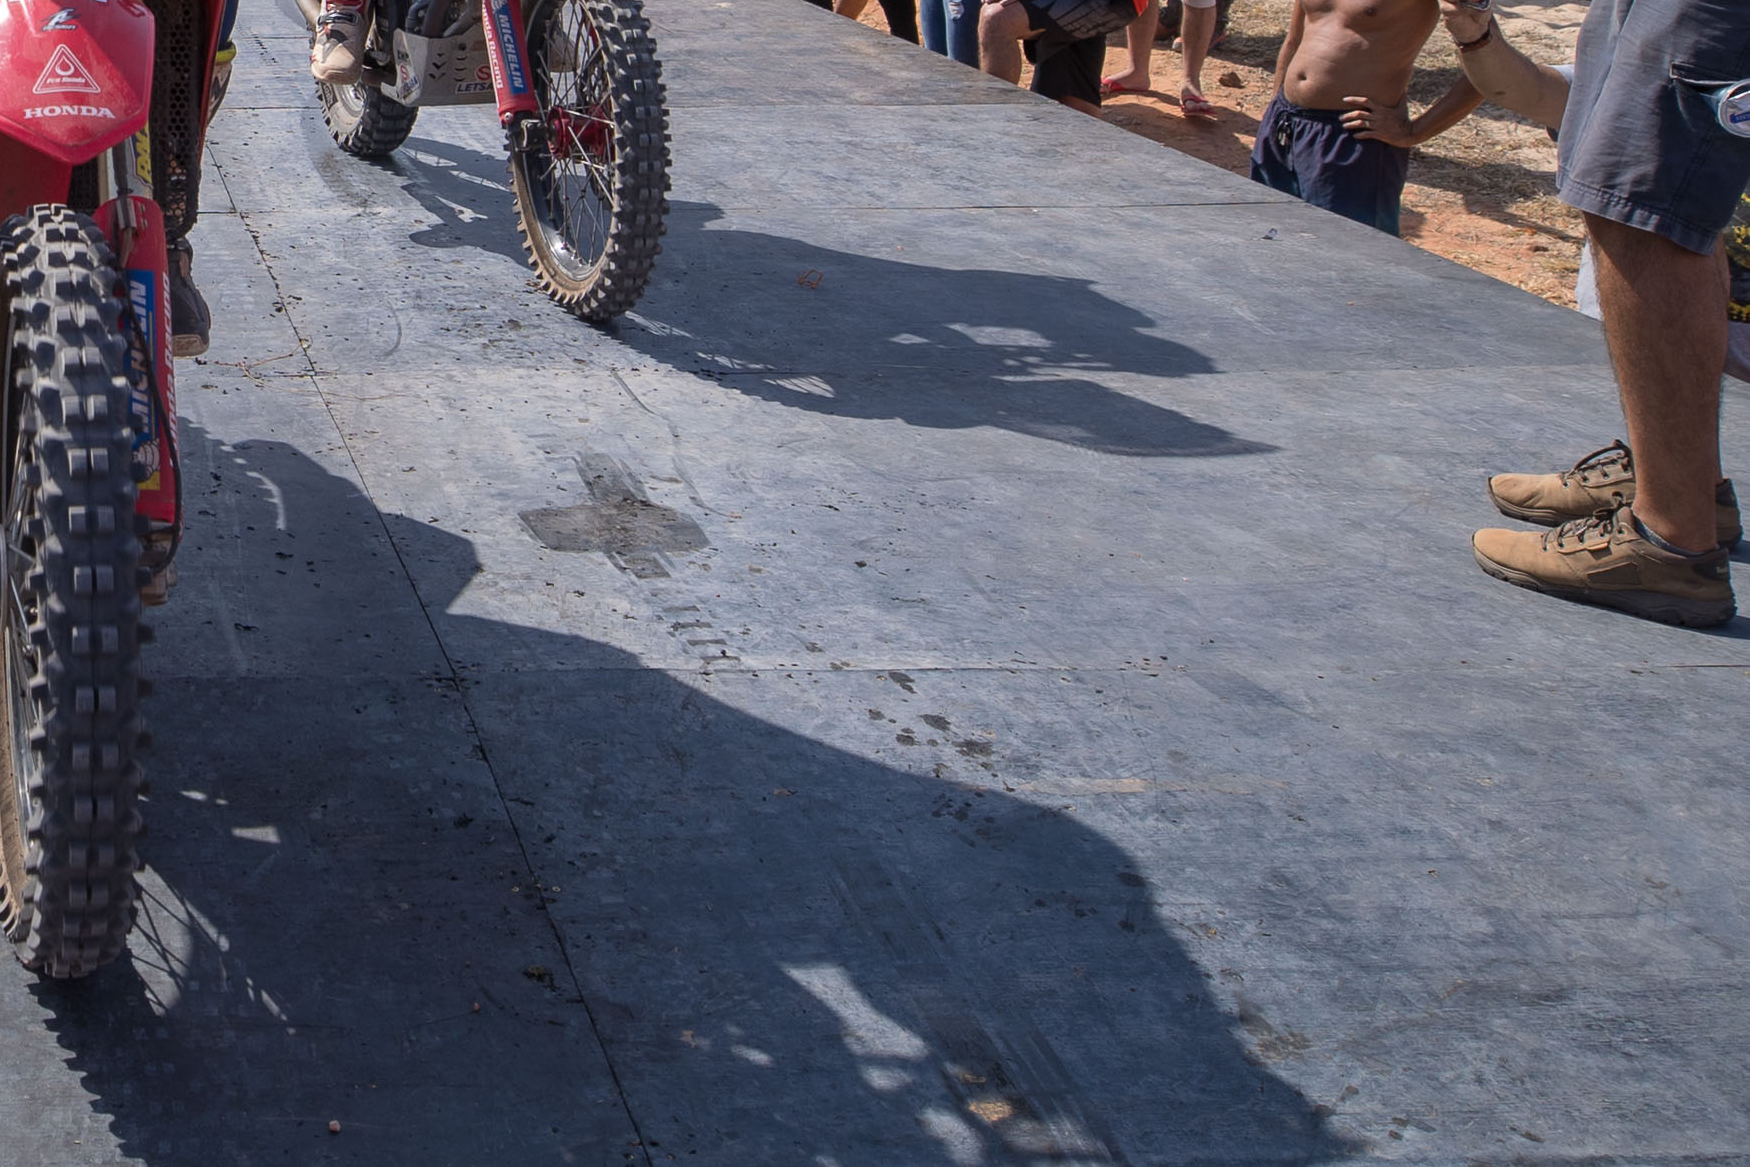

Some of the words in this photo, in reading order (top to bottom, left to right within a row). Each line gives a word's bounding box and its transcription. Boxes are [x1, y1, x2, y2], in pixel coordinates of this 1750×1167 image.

[489, 41, 504, 89] Racing
[498, 14, 524, 89] MICHELIN
[23, 105, 116, 119] HONDA
